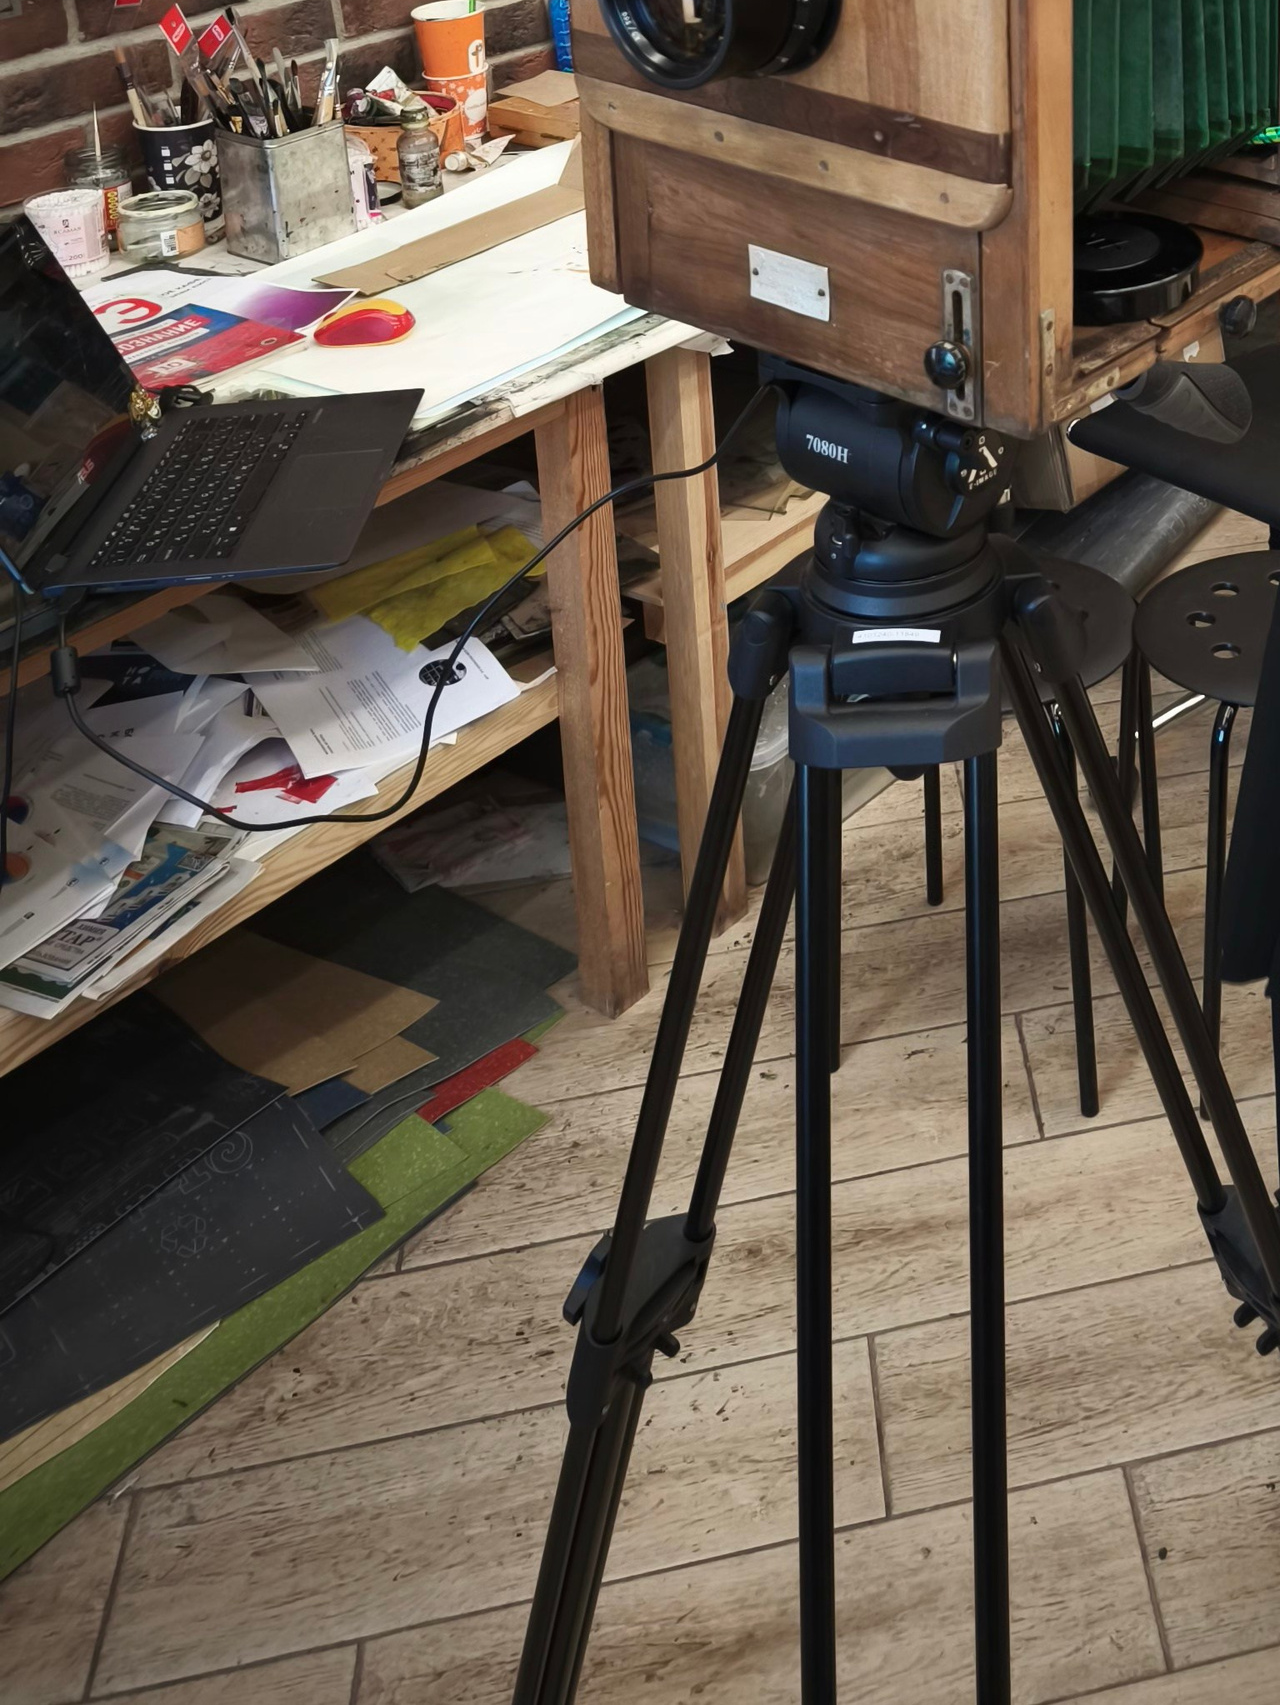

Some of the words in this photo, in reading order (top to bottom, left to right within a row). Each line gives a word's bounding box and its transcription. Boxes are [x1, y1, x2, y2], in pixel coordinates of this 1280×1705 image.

[69, 253, 84, 261] 200
[118, 318, 202, 354] ОЗНАНИЕ
[806, 434, 849, 464] 7080H
